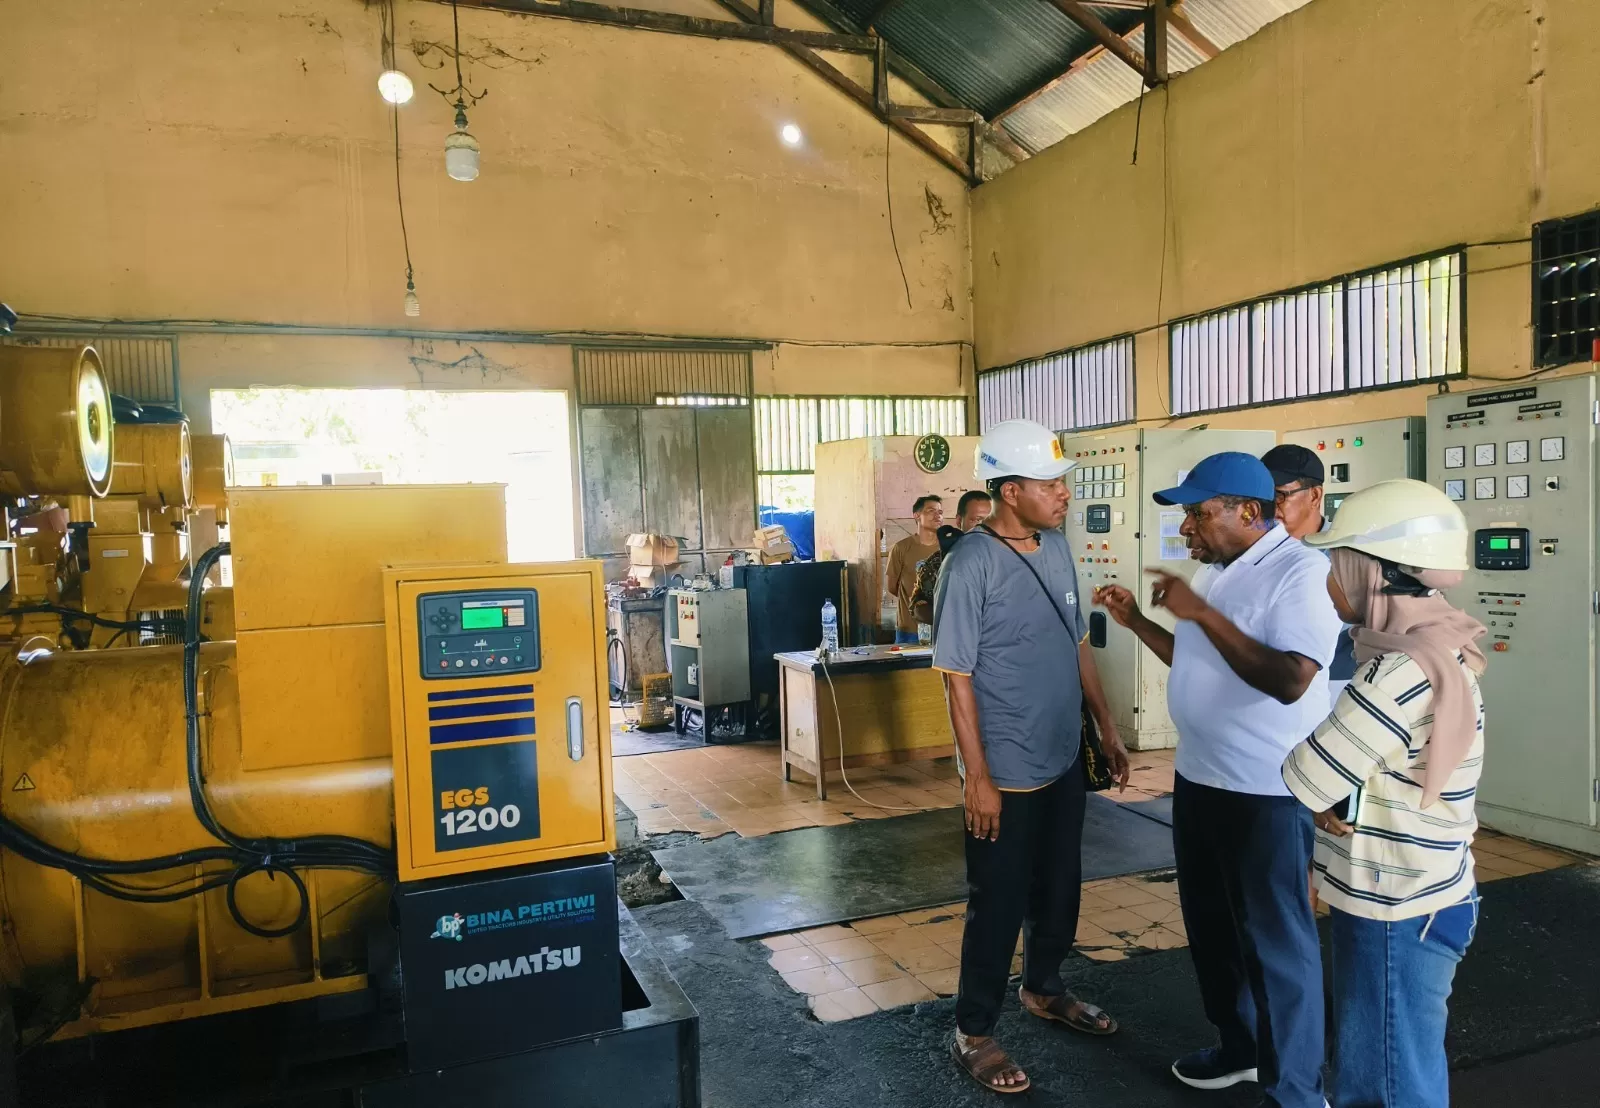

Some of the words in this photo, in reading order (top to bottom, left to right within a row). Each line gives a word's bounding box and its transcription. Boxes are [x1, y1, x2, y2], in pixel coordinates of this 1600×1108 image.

[441, 786, 490, 810] EGS
[440, 804, 521, 836] 1200
[466, 908, 514, 928] BINA
[518, 894, 595, 919] PERTIWI
[488, 921, 517, 931] TRACTORS
[516, 917, 542, 927] INDUSTRY
[547, 912, 566, 921] UTILITY
[566, 908, 596, 918] SOLUTIONS
[445, 945, 581, 990] KOMATSU
